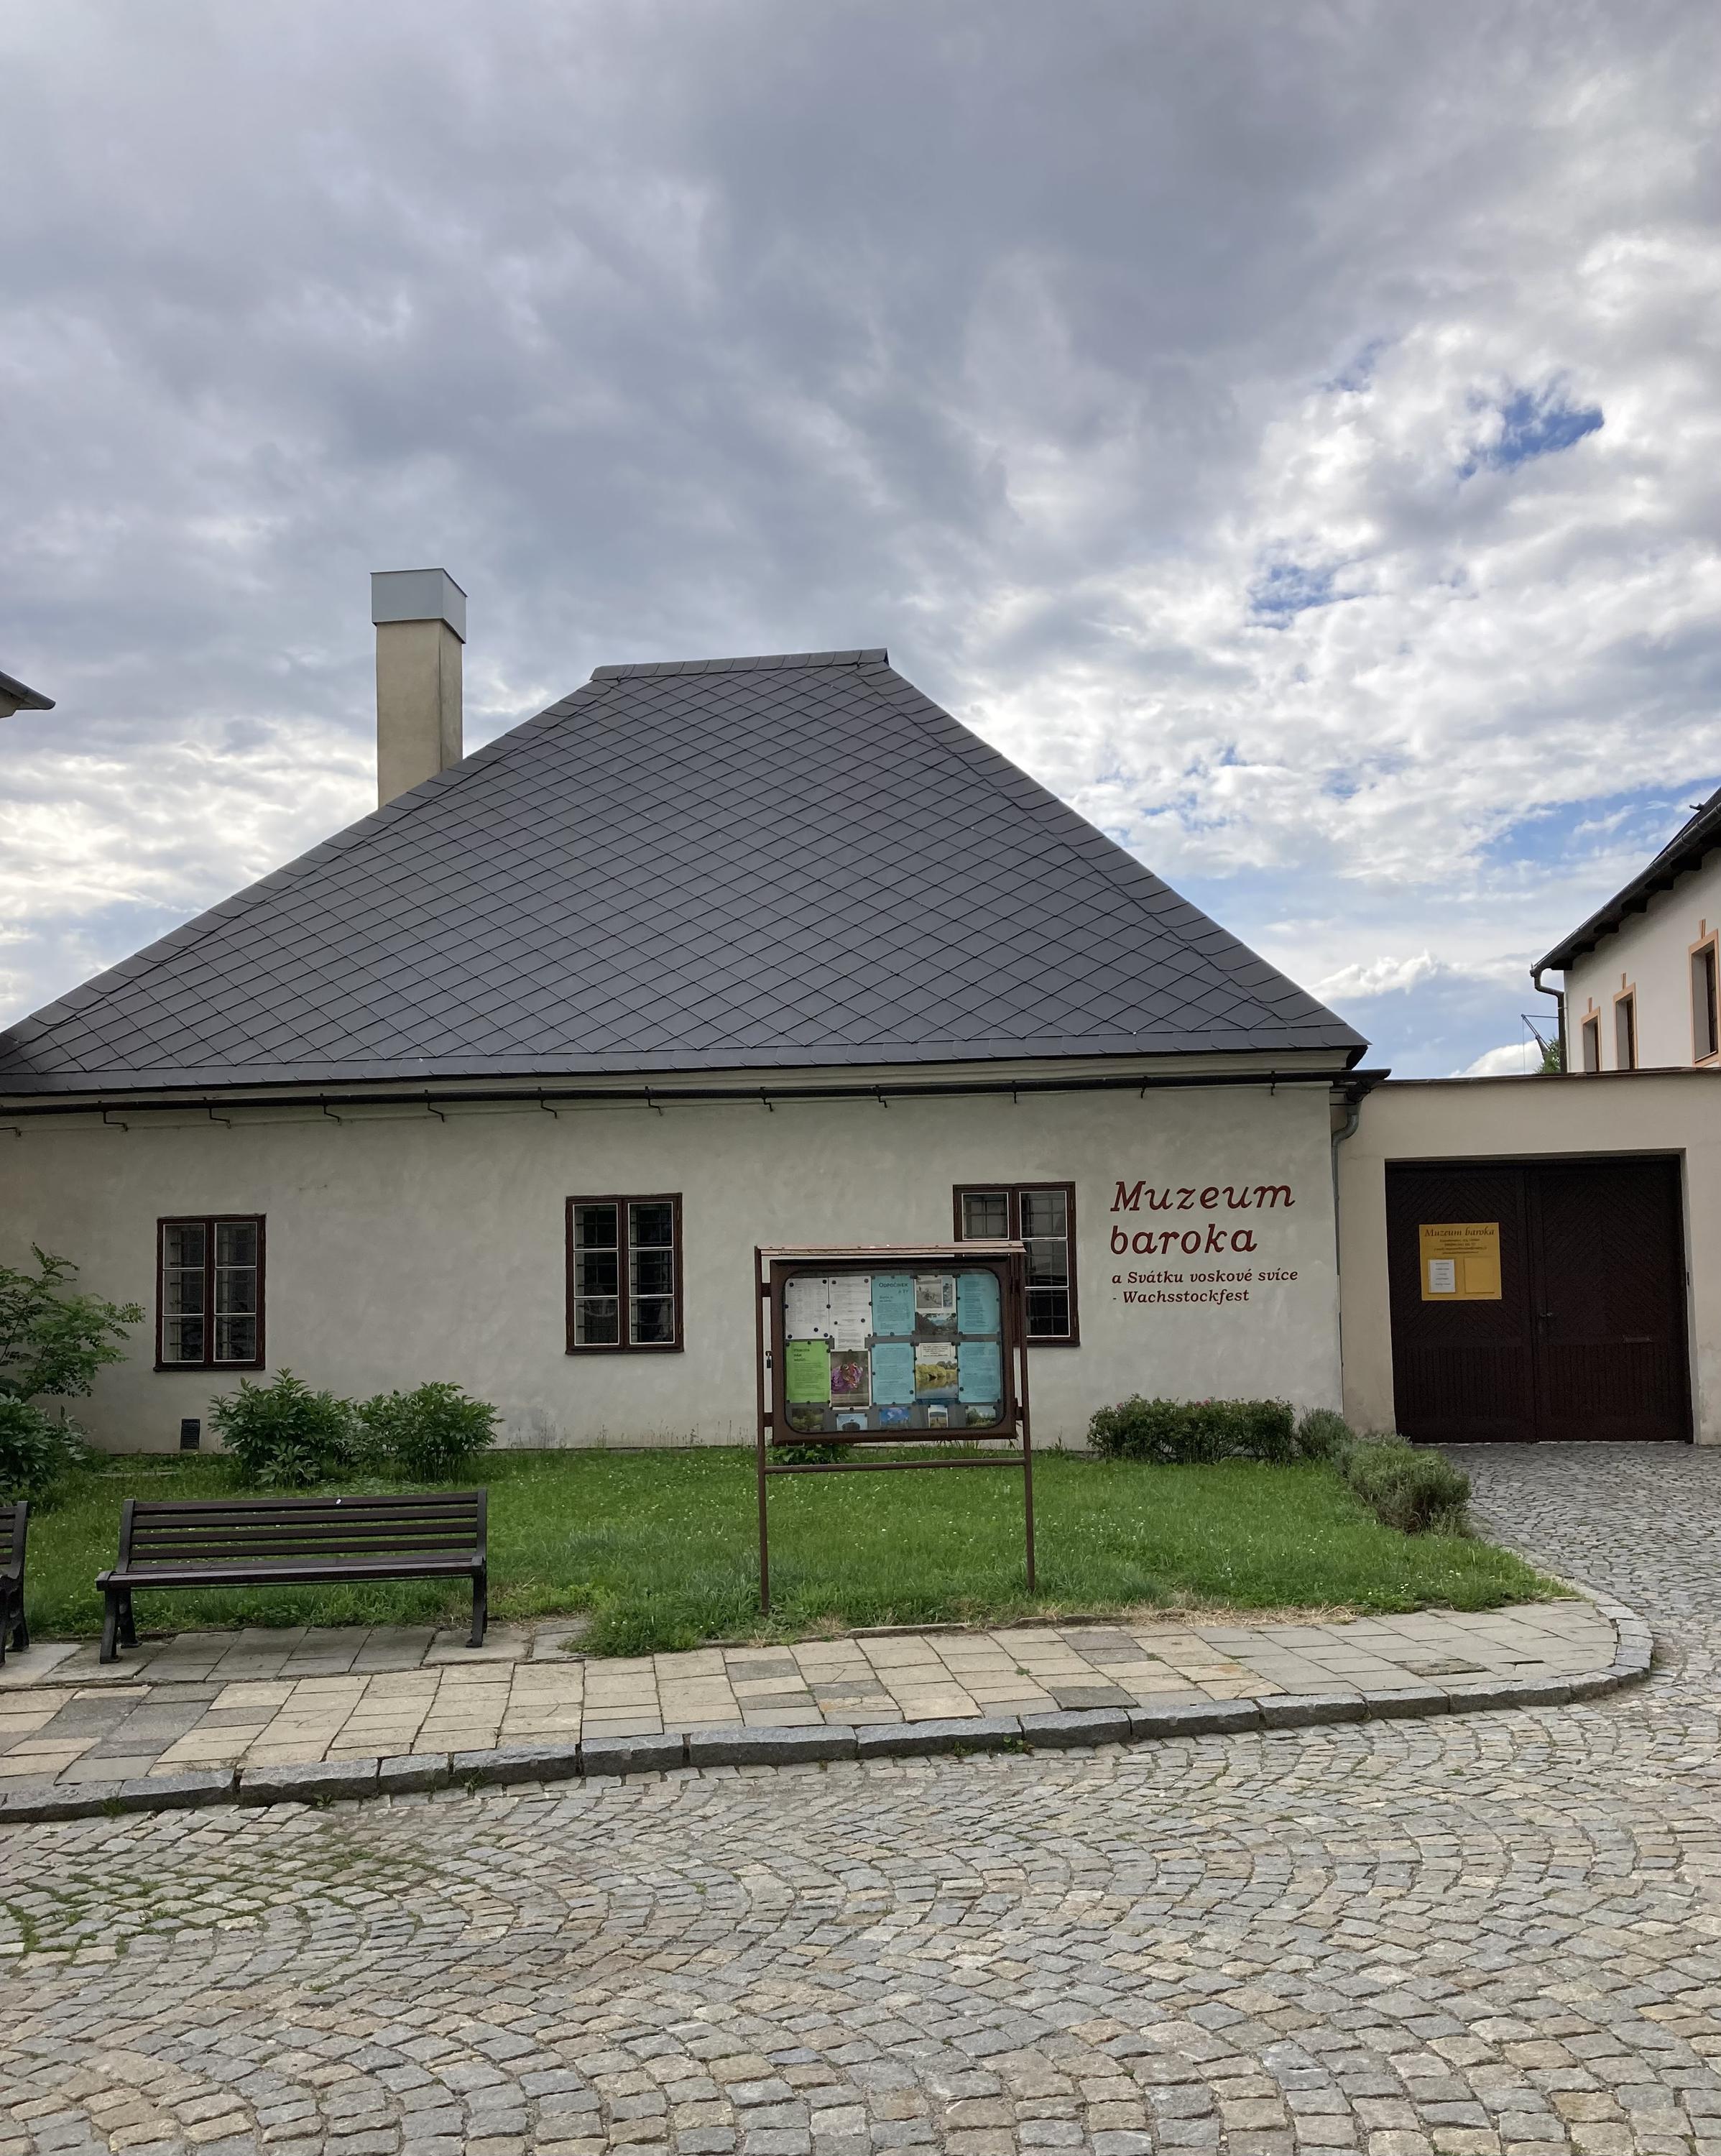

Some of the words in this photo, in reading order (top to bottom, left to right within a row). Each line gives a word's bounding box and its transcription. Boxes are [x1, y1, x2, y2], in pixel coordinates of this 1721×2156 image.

[1110, 1180, 1296, 1212] Muzeum
[1110, 1223, 1258, 1255] baroka
[1424, 1228, 1462, 1237] Muzeum
[1464, 1226, 1495, 1236] baroka
[1112, 1273, 1121, 1284] a
[1127, 1270, 1184, 1284] Svátku
[1189, 1268, 1252, 1283] voskové
[1258, 1267, 1298, 1281] svíce
[1122, 1289, 1250, 1305] Wachsstockfest
